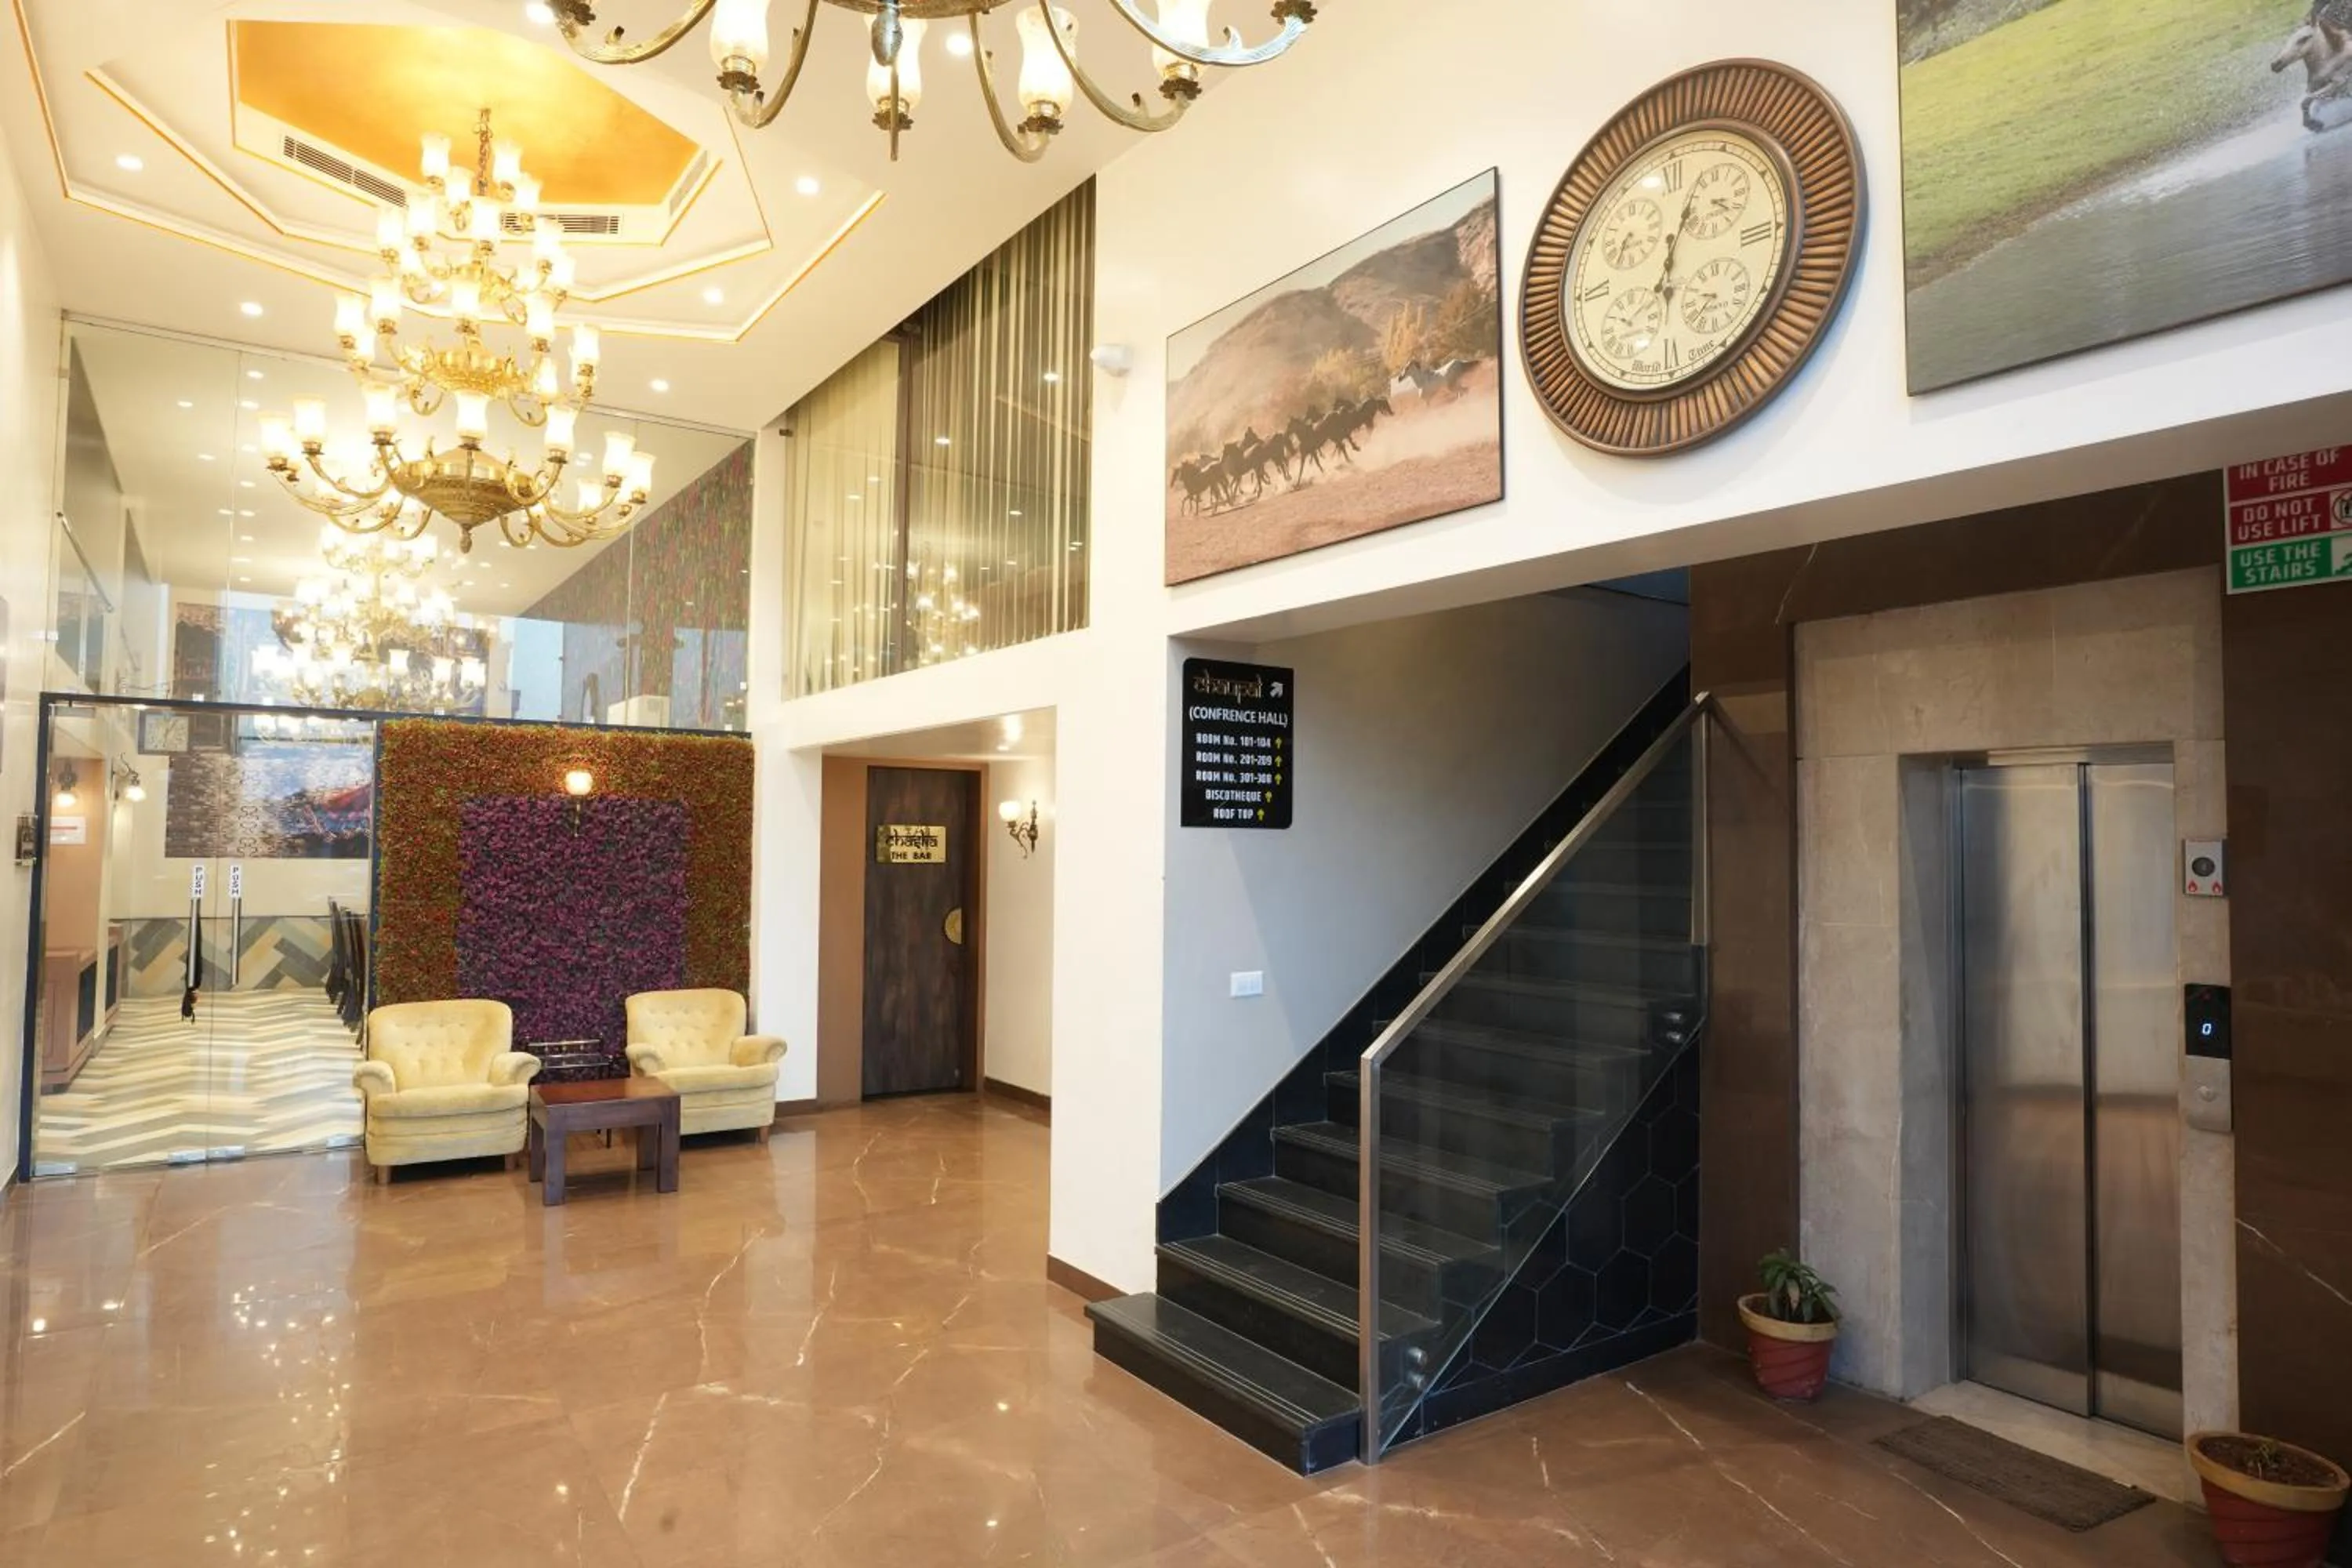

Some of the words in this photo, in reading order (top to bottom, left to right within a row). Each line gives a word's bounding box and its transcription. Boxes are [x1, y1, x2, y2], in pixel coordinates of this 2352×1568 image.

[2239, 463, 2259, 481] IN
[2263, 452, 2310, 475] CASE
[2315, 448, 2341, 466] OF
[2268, 470, 2310, 493] FIRE
[2243, 506, 2269, 524] DO
[2274, 497, 2314, 519] NOT
[2238, 521, 2274, 541] USE
[2280, 514, 2321, 535] LIFT
[2239, 548, 2277, 568] USE
[2282, 542, 2321, 562] THE
[2245, 560, 2317, 585] STAIRS
[1189, 706, 1256, 724] (CONFRENCE
[1258, 710, 1288, 728] HALL)
[1196, 732, 1221, 745] ROOM
[1196, 750, 1221, 763] ROOM
[1196, 770, 1221, 782] ROOM
[1205, 789, 1261, 802] DISCOTHEQUE
[1213, 808, 1235, 819] ROOF
[1237, 808, 1254, 820] TOP
[195, 866, 204, 895] PUSH
